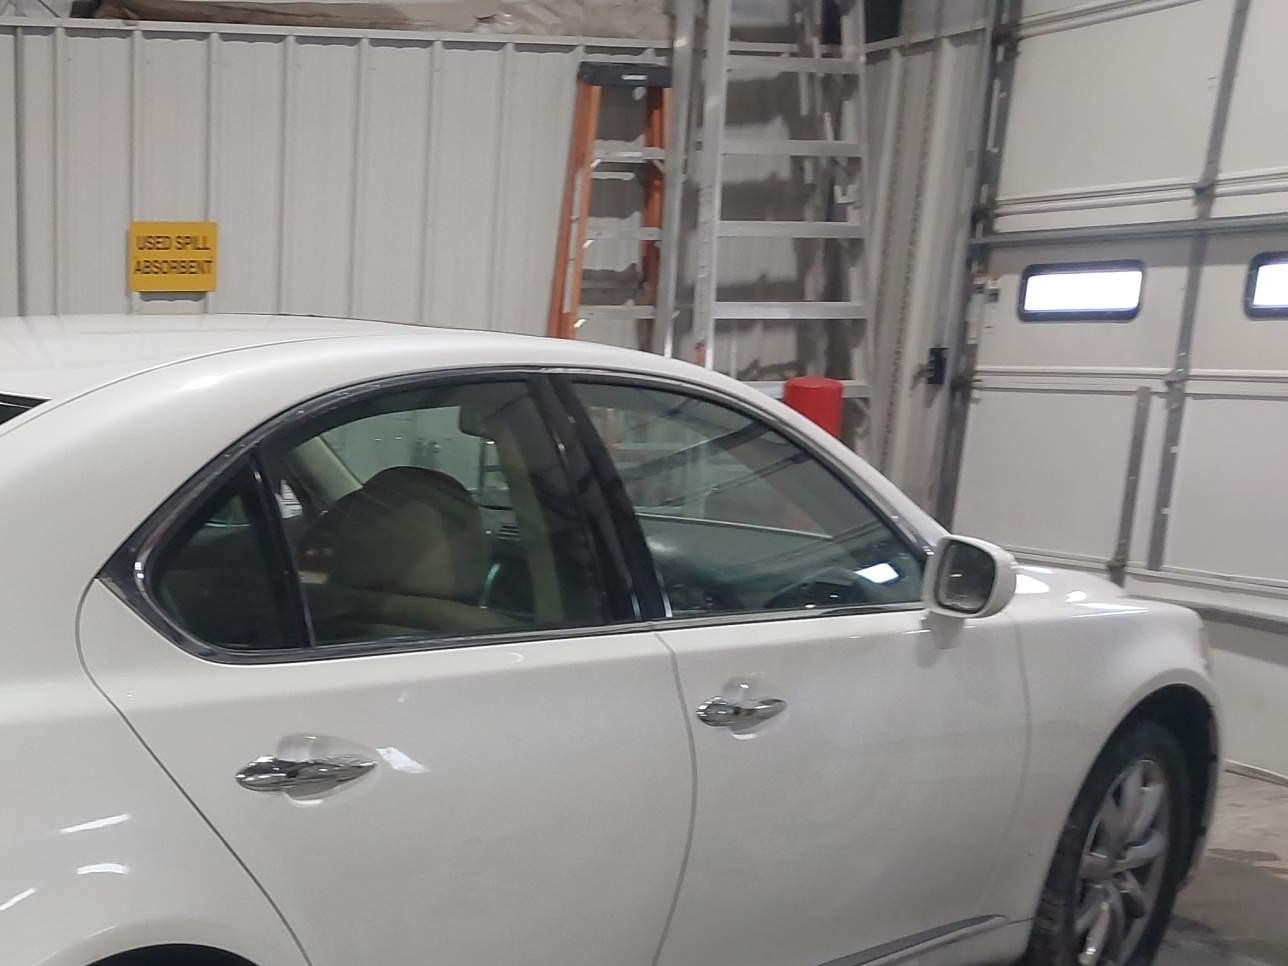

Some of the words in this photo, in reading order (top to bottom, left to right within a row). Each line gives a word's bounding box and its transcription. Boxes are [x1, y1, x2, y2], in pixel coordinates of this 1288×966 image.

[136, 235, 171, 251] USED
[175, 235, 210, 251] SPILL
[134, 259, 213, 275] ABSORBENT
